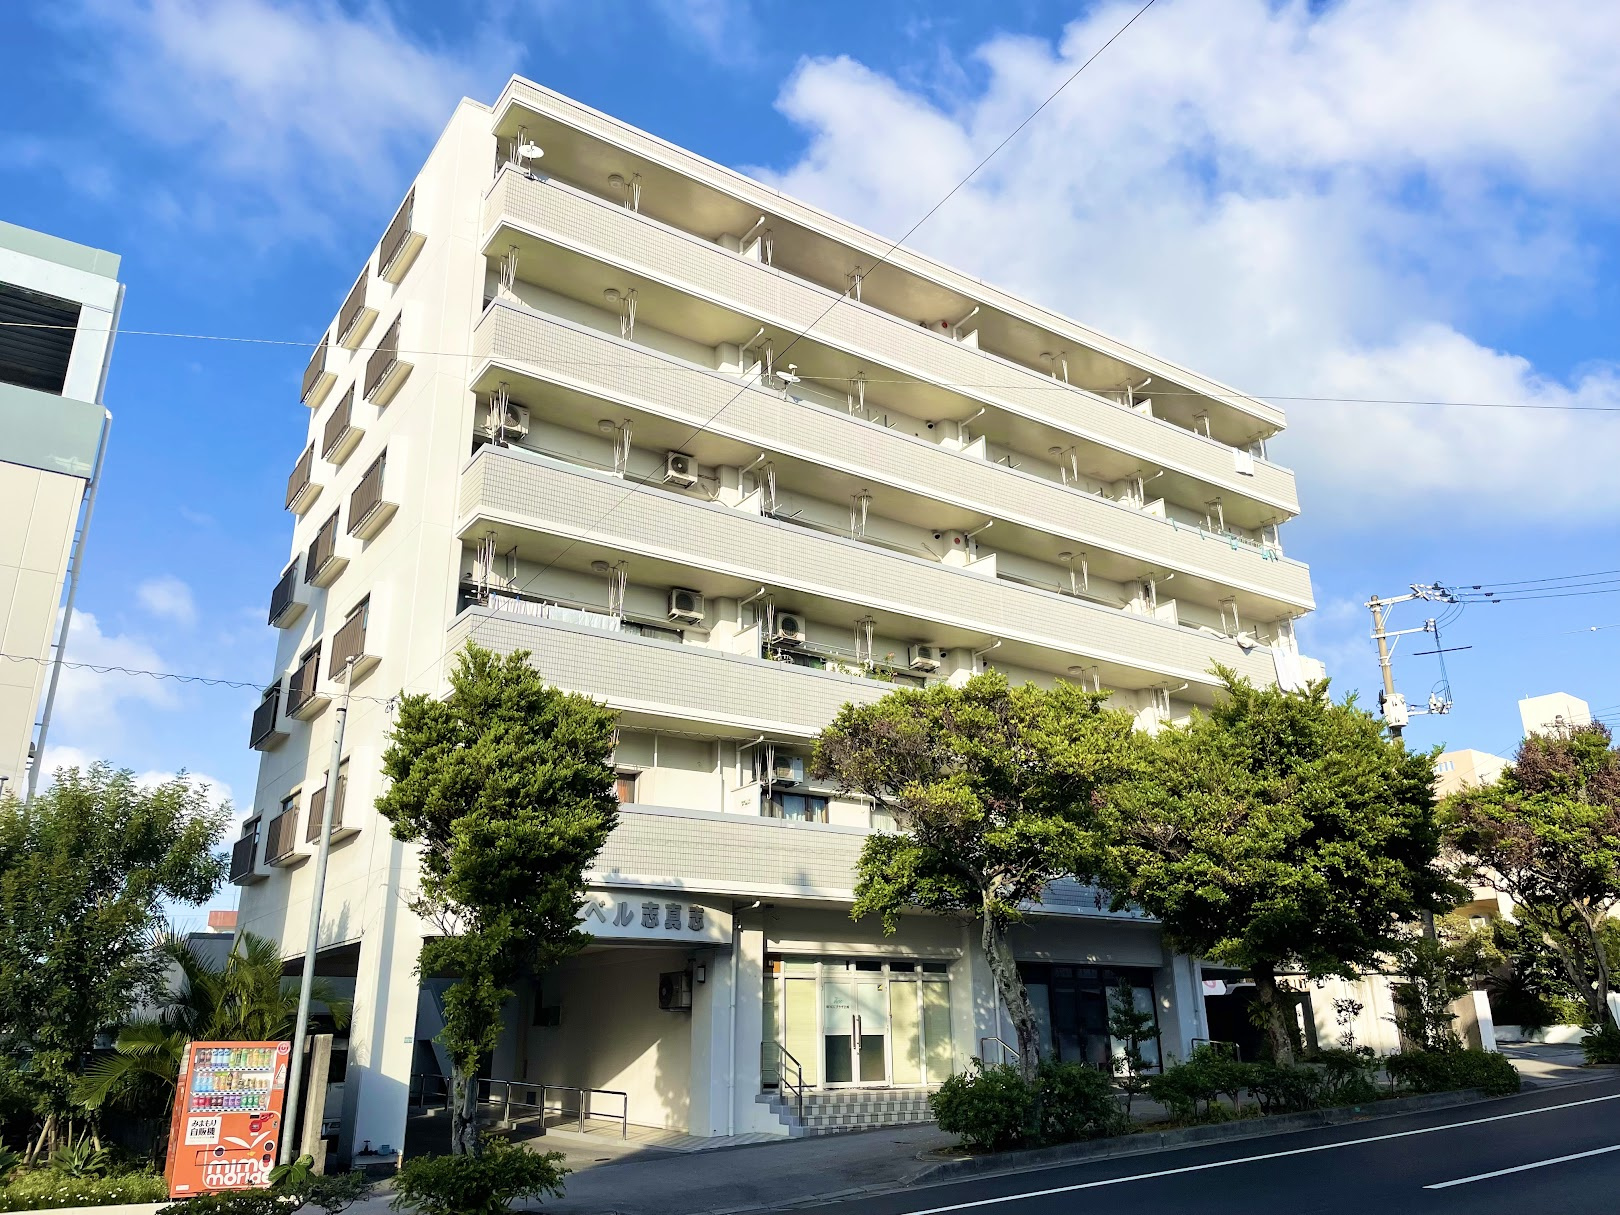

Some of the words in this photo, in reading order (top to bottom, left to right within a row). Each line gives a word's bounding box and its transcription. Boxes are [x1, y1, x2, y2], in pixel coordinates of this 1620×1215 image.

[191, 1119, 217, 1127] みまもり
[190, 1127, 215, 1136] 自販機
[207, 1158, 273, 1174] mimo
